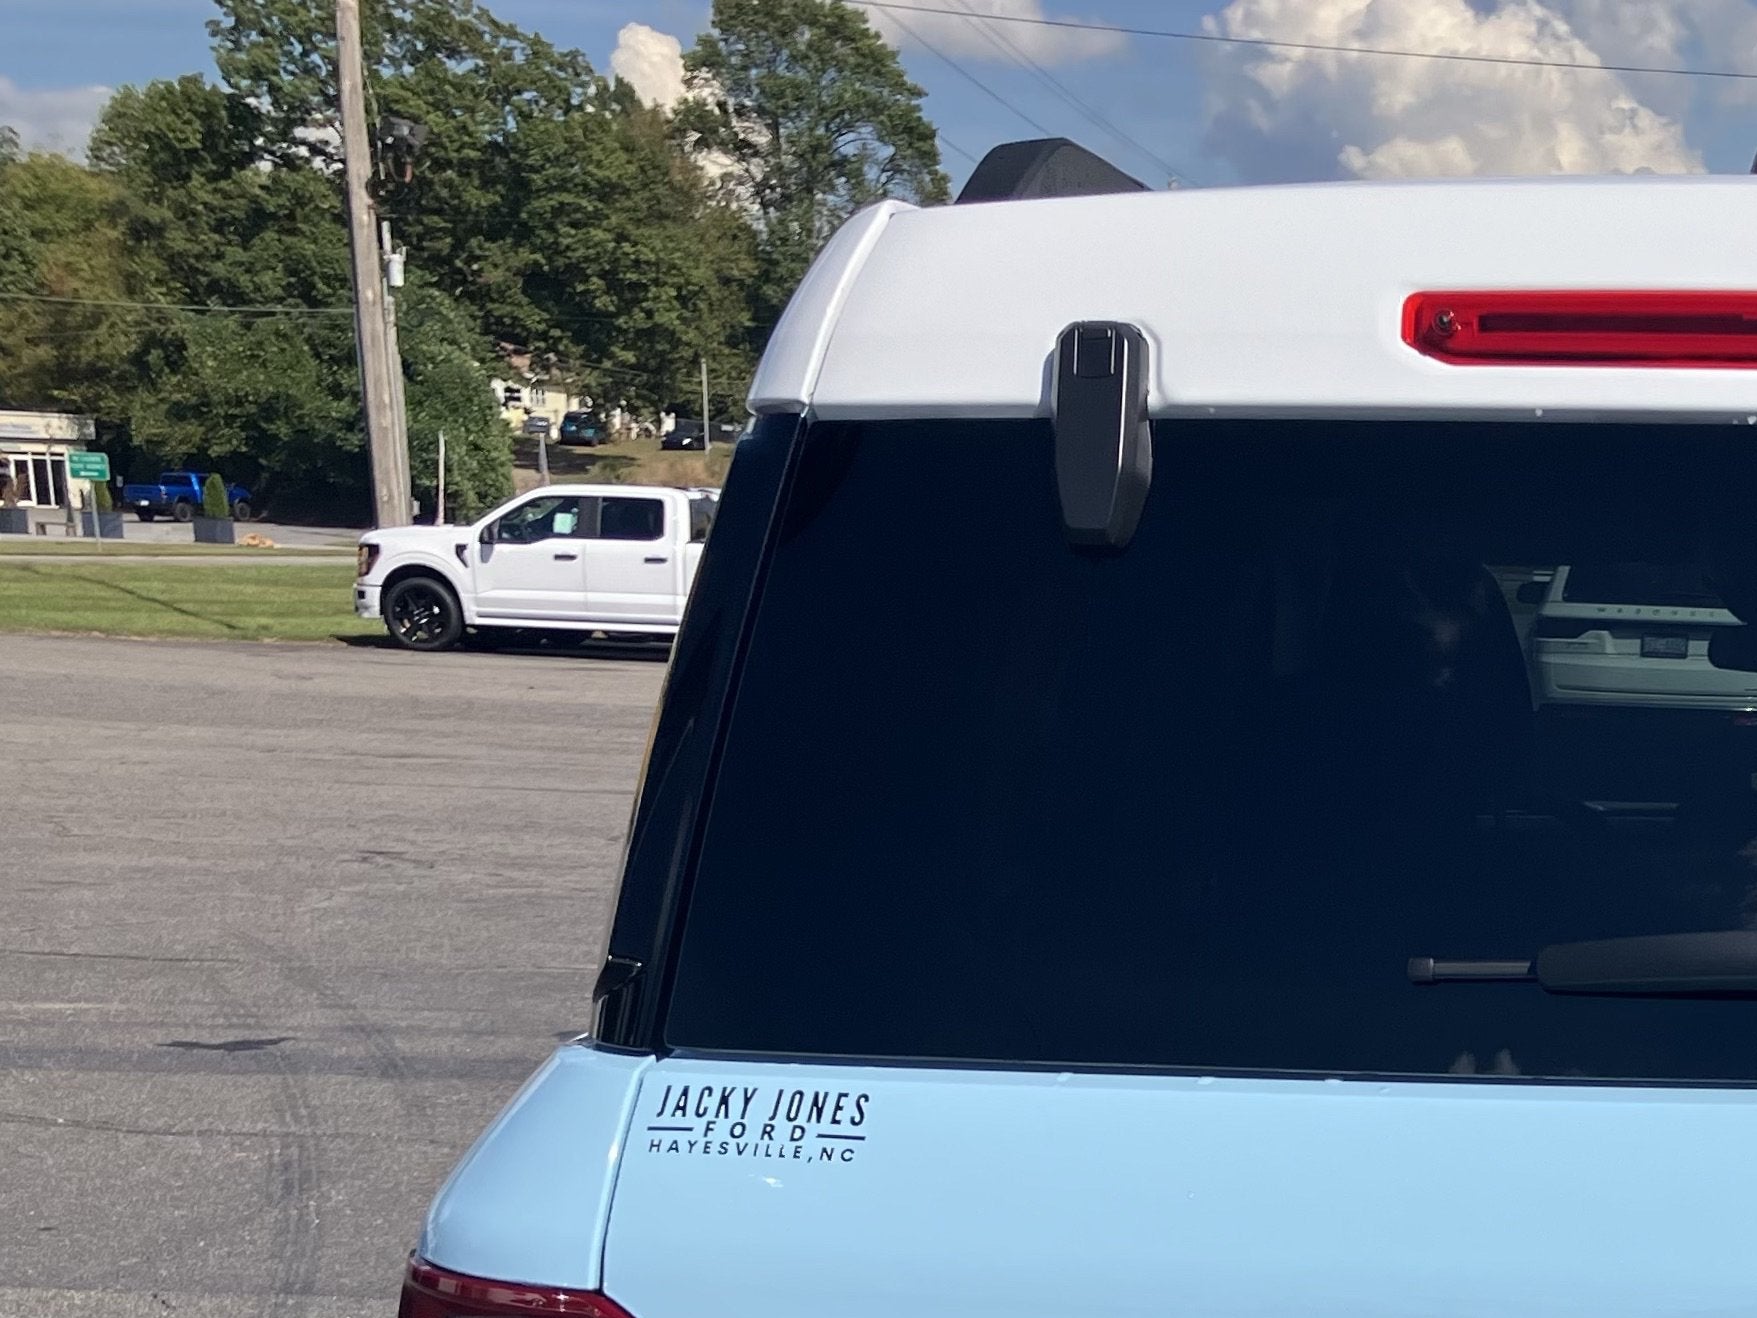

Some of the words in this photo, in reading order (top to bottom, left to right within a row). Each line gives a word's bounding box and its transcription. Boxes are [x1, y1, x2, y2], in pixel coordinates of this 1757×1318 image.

[656, 1085, 759, 1120] JACKY
[768, 1089, 870, 1127] JONES
[703, 1121, 807, 1142] FORD
